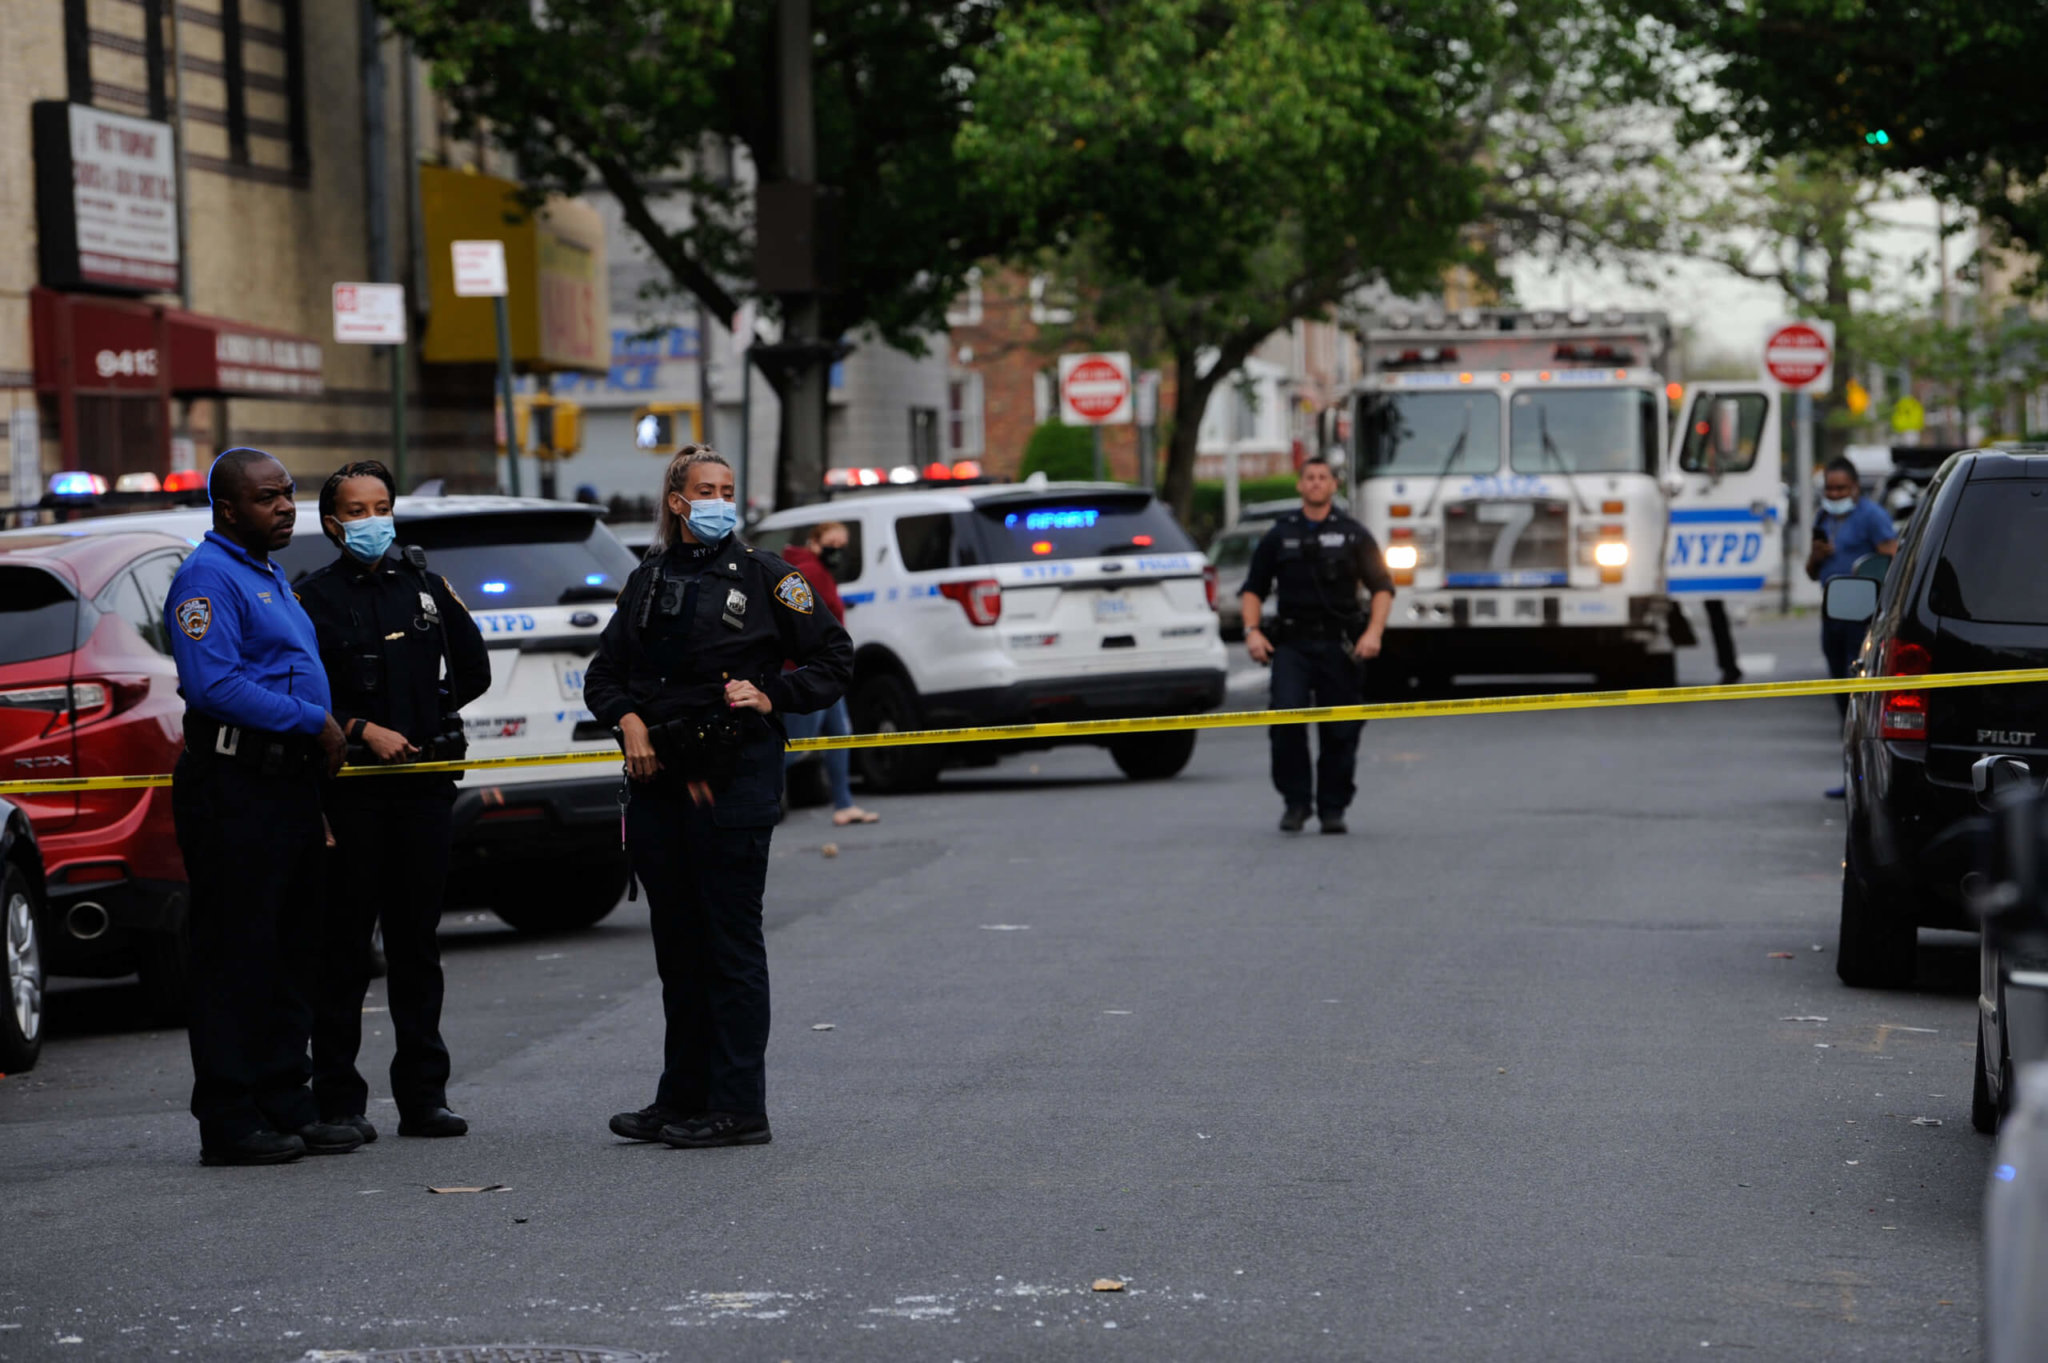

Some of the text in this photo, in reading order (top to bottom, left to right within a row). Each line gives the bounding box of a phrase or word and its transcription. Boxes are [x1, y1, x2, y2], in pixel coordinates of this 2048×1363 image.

[1477, 500, 1535, 571] 7
[1669, 532, 1762, 566] NYPD
[1977, 729, 2036, 746] PILOT
[14, 755, 71, 769] RDX
